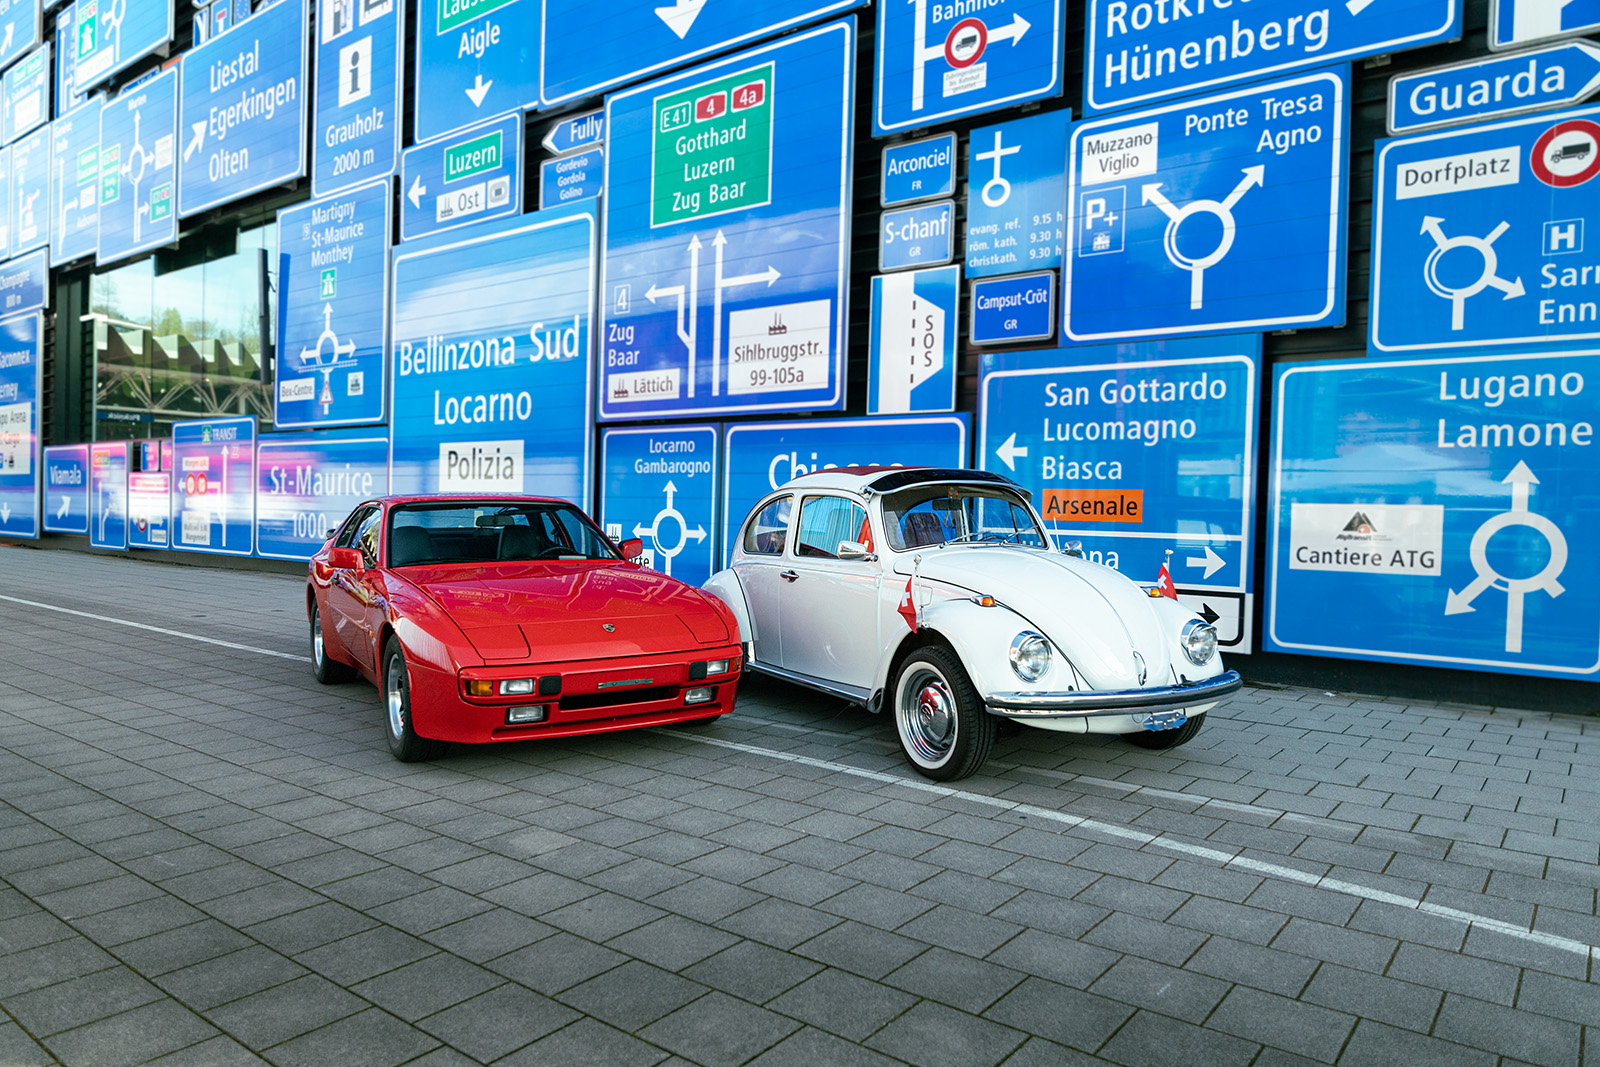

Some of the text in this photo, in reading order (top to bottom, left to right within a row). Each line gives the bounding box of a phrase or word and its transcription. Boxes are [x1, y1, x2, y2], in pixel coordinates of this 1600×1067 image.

[458, 20, 500, 58] Aigle
[1105, 9, 1329, 87] Hünenberg
[210, 40, 258, 93] Liestal
[1410, 59, 1565, 115] Guarda
[210, 77, 295, 140] Egerkingen
[664, 89, 756, 127] E 41 4 4a
[1186, 94, 1322, 136] Ponte Tresa
[326, 107, 384, 147] Grauholz
[571, 115, 602, 142] Fully
[676, 118, 746, 155] Gotthard
[1256, 125, 1322, 154] Agno
[1087, 132, 1152, 156] Muzzano
[209, 148, 248, 182] Olten
[333, 149, 374, 176] 2000 m
[450, 145, 496, 175] Luzern
[556, 158, 588, 174] Gordevio
[684, 157, 734, 182] Luzern
[888, 146, 950, 176] Arconciel
[1099, 153, 1139, 175] Viglio
[1405, 158, 1510, 186] Dorfplatz
[558, 172, 586, 186] Gordola
[912, 180, 922, 190] FR
[458, 191, 479, 211] Ost
[560, 186, 583, 200] Golino
[673, 181, 746, 212] Zug Baar
[312, 200, 356, 225] Martigny
[970, 212, 1063, 236] evang. ref. 9.15 h
[312, 222, 364, 248] St-Maurice
[886, 211, 948, 244] S-chanf
[1551, 224, 1575, 250] H
[909, 247, 921, 257] GR
[970, 230, 1062, 252] röm. kath. 9.30 h
[311, 245, 354, 268] Monthey
[969, 246, 1061, 268] christkath. 9.30 h
[617, 289, 627, 310] 4
[978, 289, 1047, 311] Campsut-Cröt
[609, 324, 634, 345] Zug
[1004, 320, 1018, 330] GR
[400, 314, 579, 376] Bellinzona Sud
[734, 340, 823, 363] Sihlbruggstr.
[608, 349, 640, 367] Baar
[634, 376, 673, 394] Lättich
[750, 367, 804, 386] 99-105a
[1440, 371, 1584, 407] Lugano
[281, 383, 313, 397] Bex-Centre
[1045, 372, 1226, 407] San Gottardo
[434, 390, 532, 425] Locarno
[212, 427, 237, 440] TRANSIT
[1044, 418, 1196, 446] Lucomagno
[1438, 419, 1592, 448] Lamone
[650, 438, 695, 453] Locarno
[50, 464, 81, 485] Viamala
[448, 448, 514, 480] Polizia
[635, 458, 710, 477] Gambarogno
[1042, 456, 1122, 480] Biasca
[270, 463, 372, 496] St-Maurice
[1047, 495, 1137, 516] Arsenale
[293, 512, 326, 539] 1000
[1296, 546, 1434, 568] Cantiere ATG
